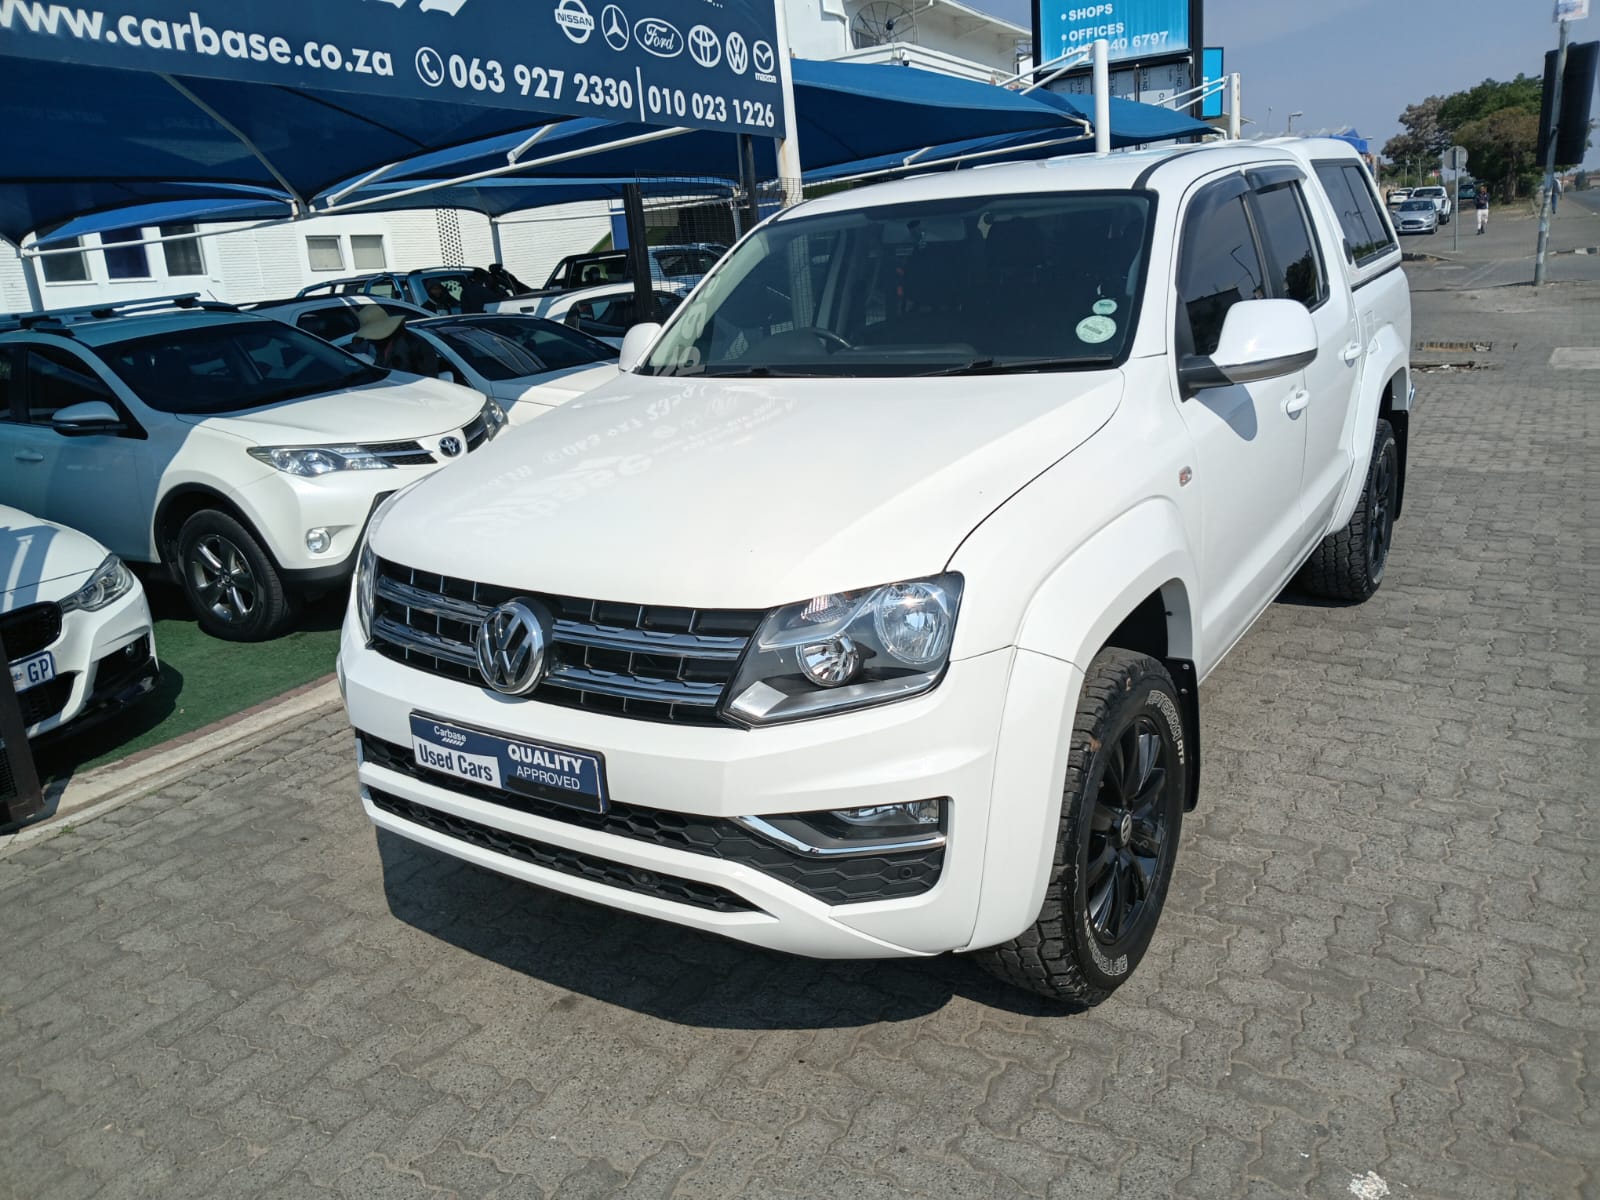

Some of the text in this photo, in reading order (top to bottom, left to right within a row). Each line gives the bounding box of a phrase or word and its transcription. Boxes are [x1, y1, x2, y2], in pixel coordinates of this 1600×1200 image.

[556, 13, 594, 28] NISSAN
[1068, 4, 1113, 20] SHOPS
[644, 23, 675, 51] Ford
[1068, 23, 1125, 40] OFFICES
[1132, 31, 1169, 48] 6797
[449, 54, 634, 110] 063 927 2330
[648, 85, 775, 128] 010 023 1226
[27, 659, 50, 683] GP
[433, 724, 467, 742] Carbase
[418, 742, 494, 781] Used Cars
[507, 743, 583, 774] QUALITY
[516, 764, 581, 790] APPROVED
